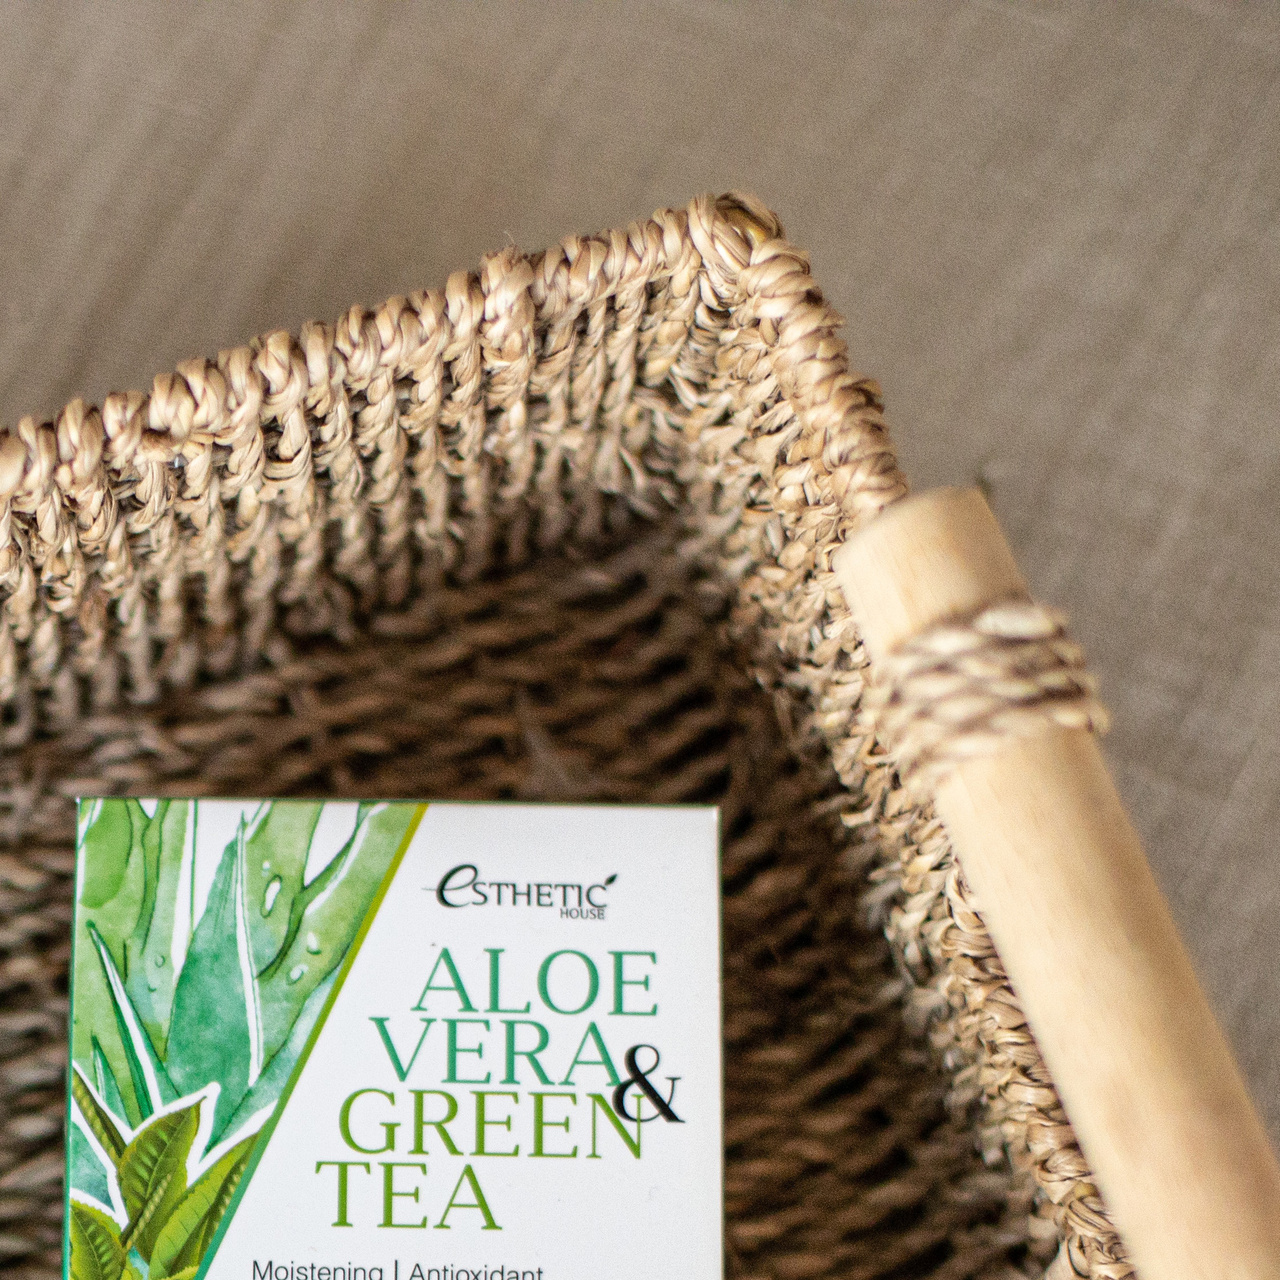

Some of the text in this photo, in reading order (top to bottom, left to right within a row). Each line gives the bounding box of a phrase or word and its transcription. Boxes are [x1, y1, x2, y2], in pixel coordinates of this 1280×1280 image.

[559, 907, 606, 920] HOUSE
[409, 947, 659, 1016] ALOE
[369, 1017, 686, 1123] VERA &
[338, 1088, 645, 1160] GREEN
[315, 1160, 503, 1231] TEA
